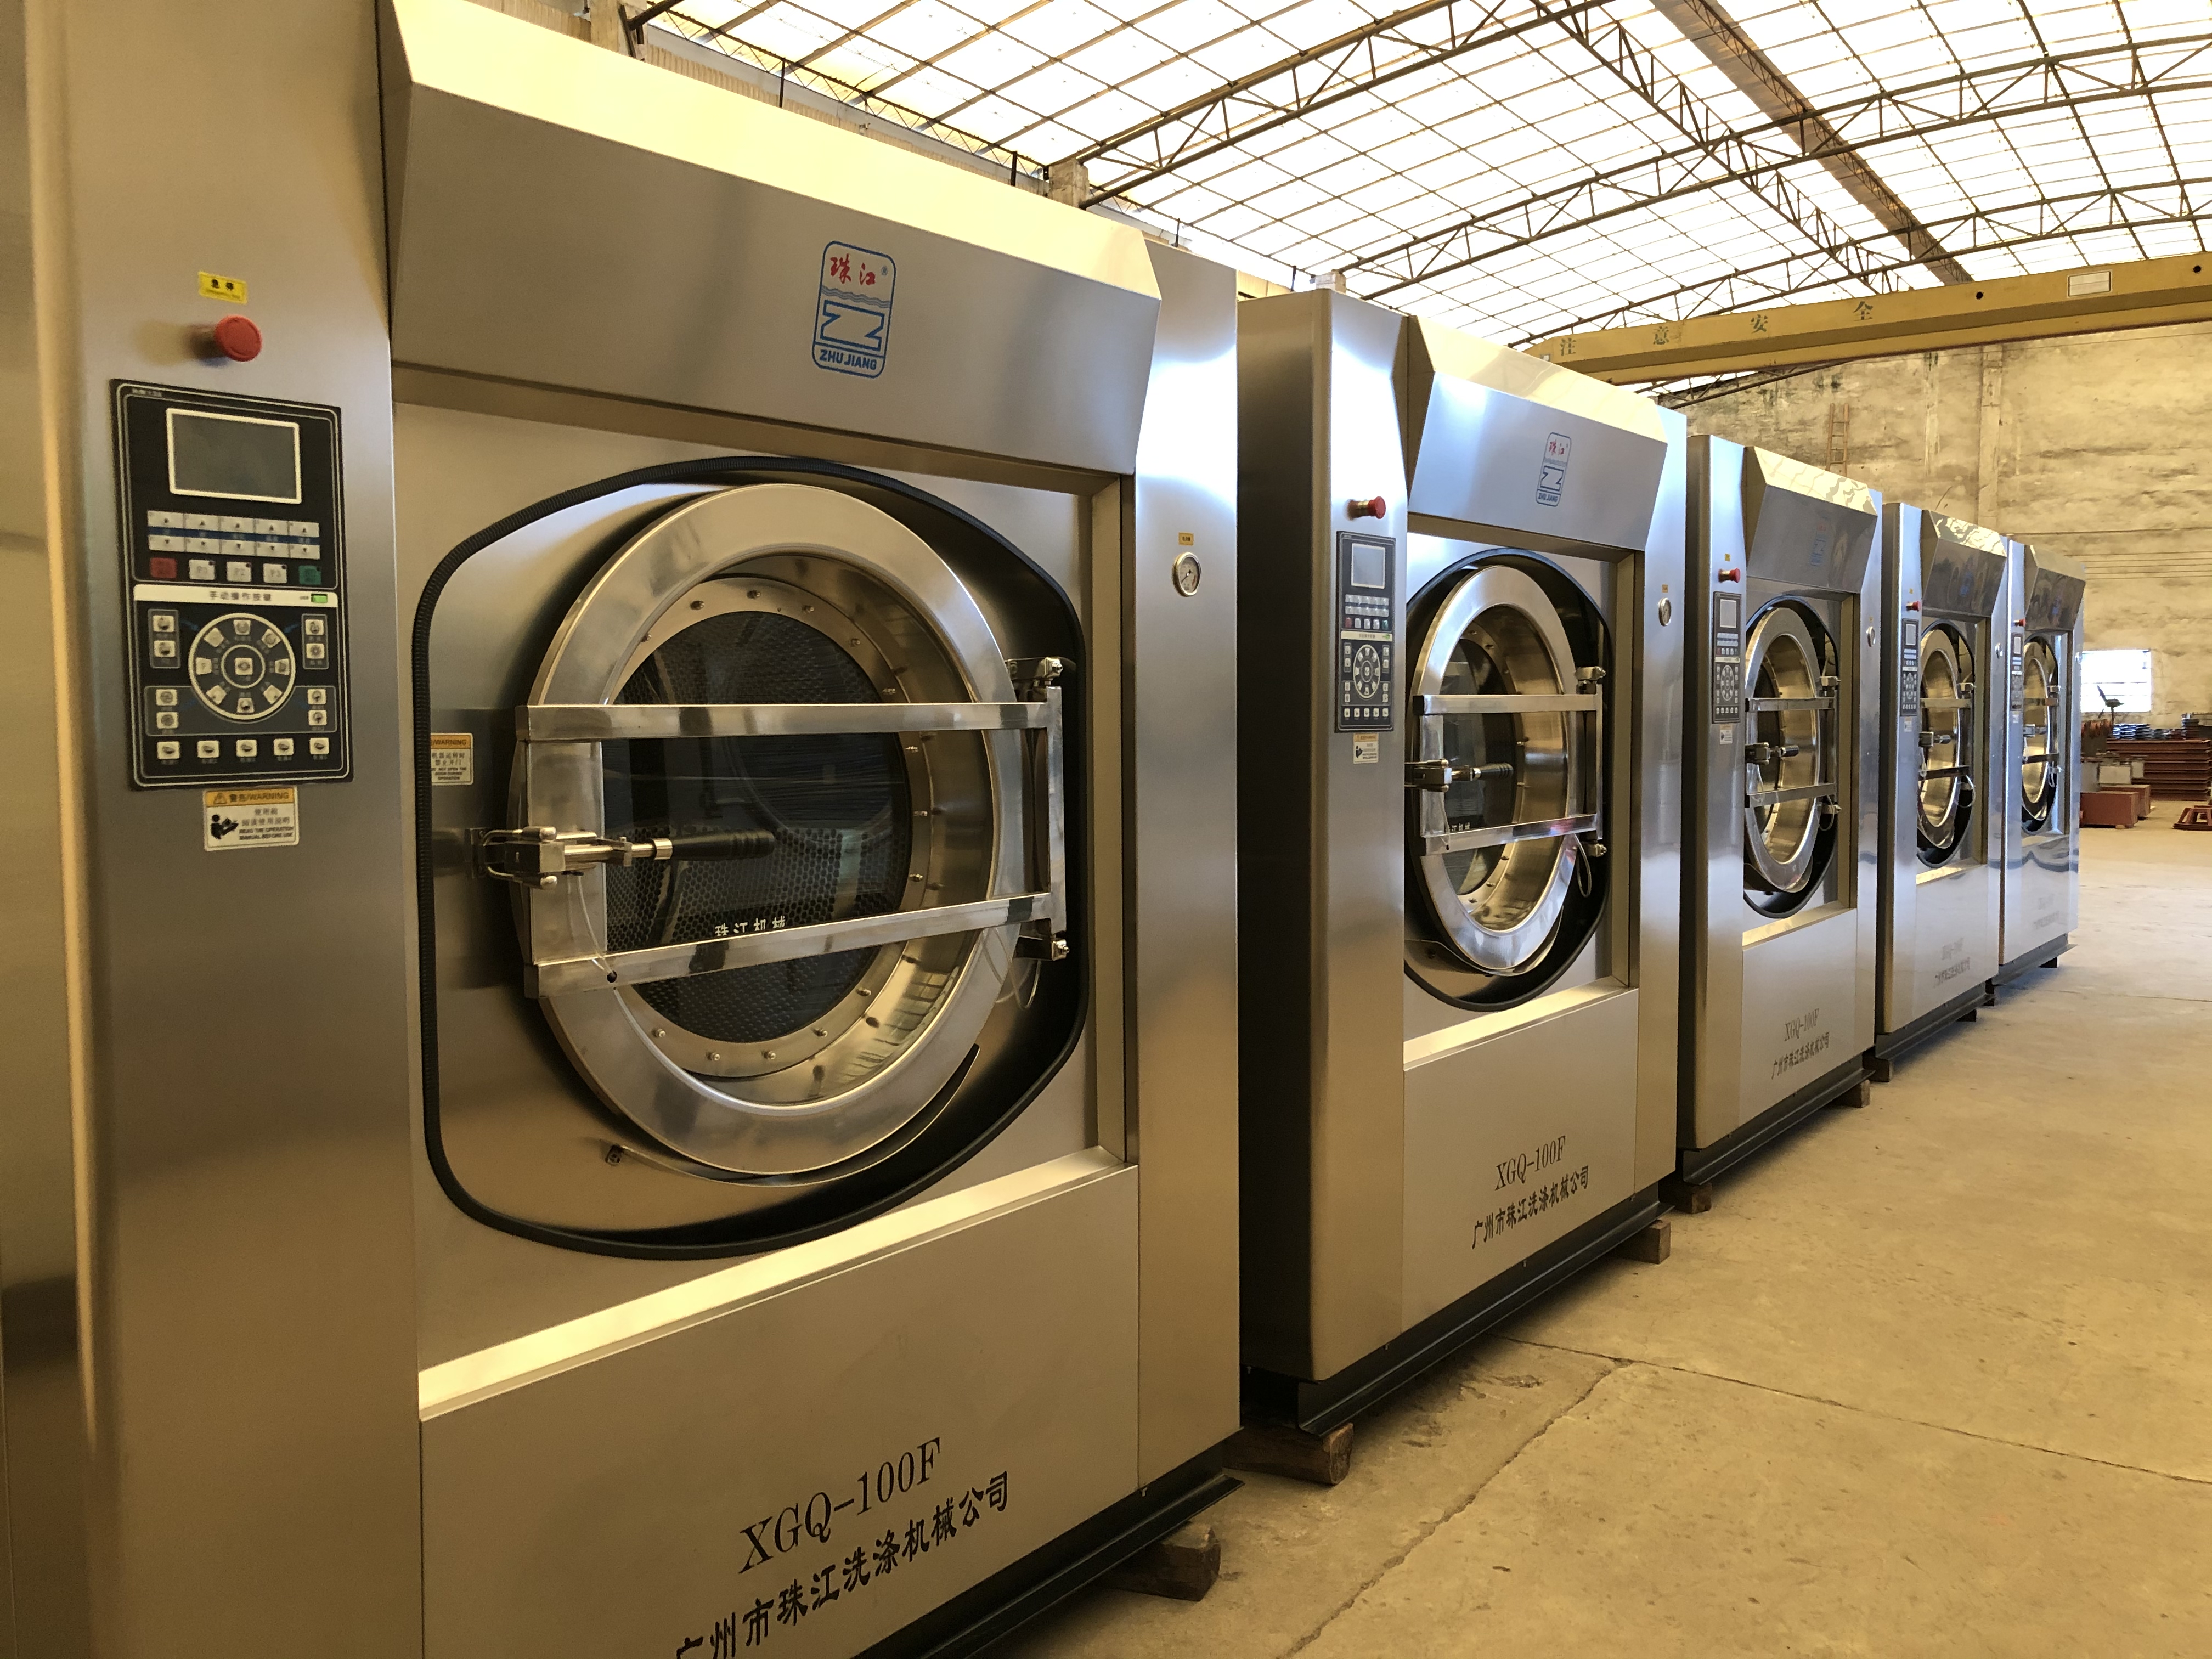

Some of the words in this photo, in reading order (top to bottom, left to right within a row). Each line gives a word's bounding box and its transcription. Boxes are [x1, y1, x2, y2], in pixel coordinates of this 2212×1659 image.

[830, 253, 876, 285] 珠江
[1494, 1135, 1566, 1191] XGQ-100F
[1471, 1165, 1589, 1250] 广州市珠江洗涤机械公司
[738, 1437, 941, 1574] XGQ-100F
